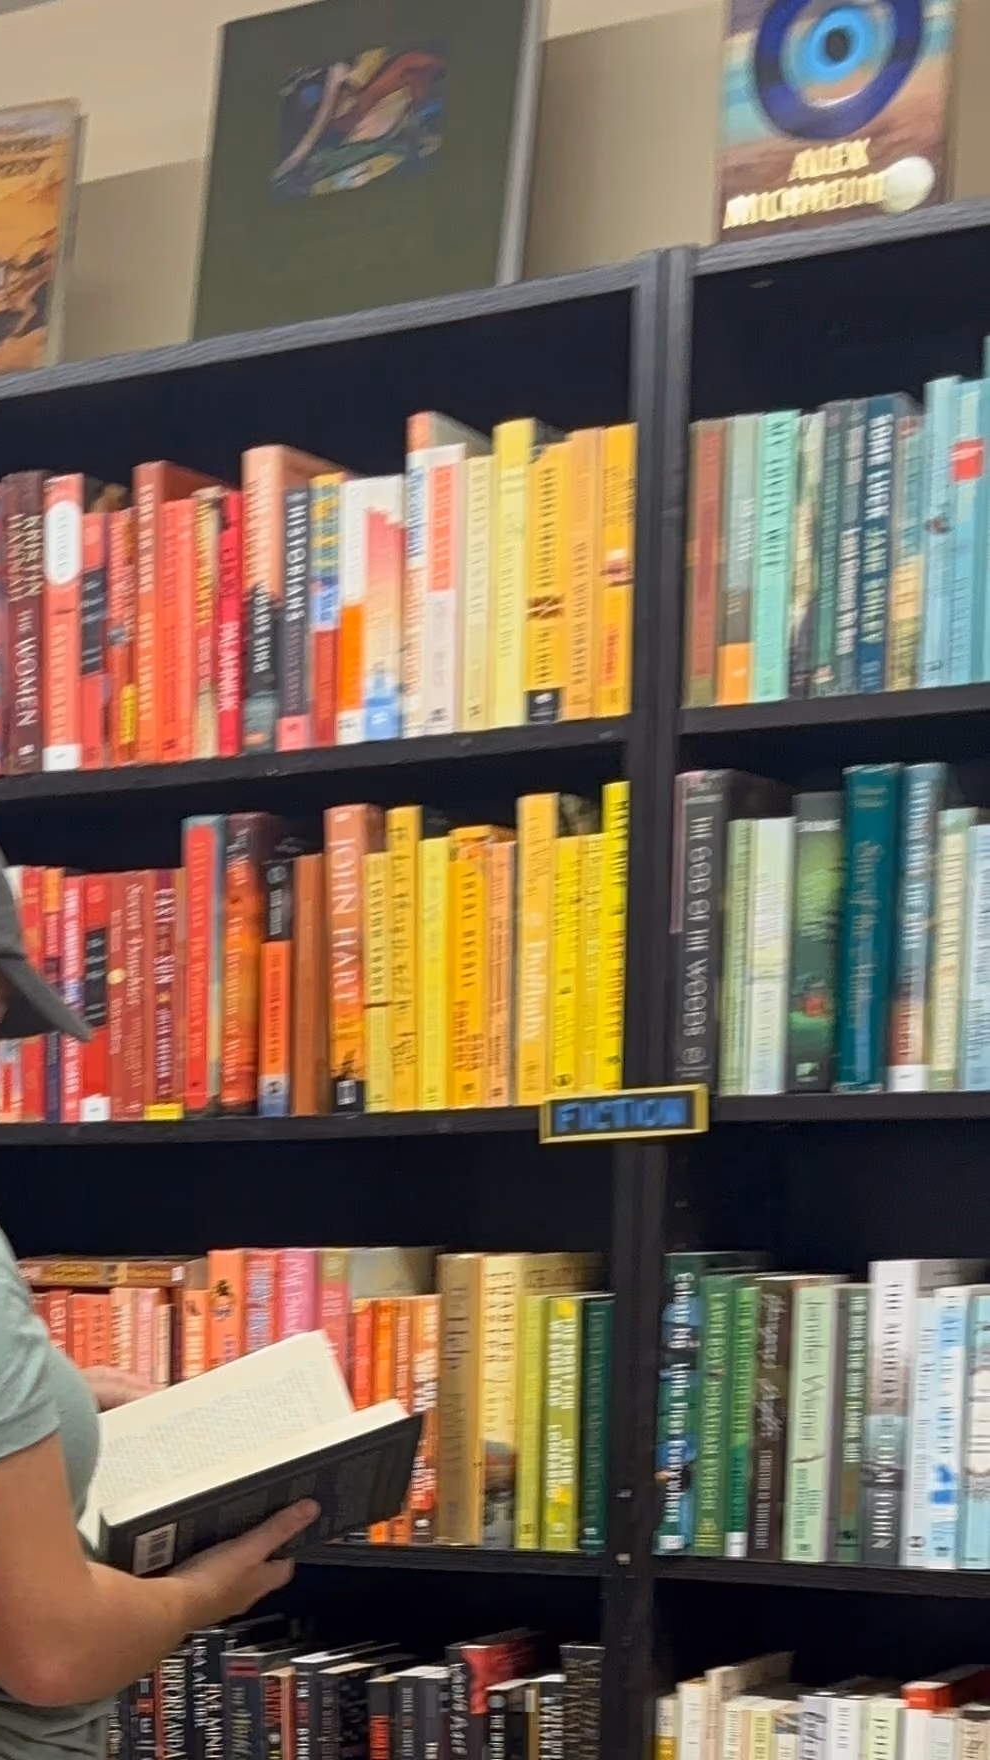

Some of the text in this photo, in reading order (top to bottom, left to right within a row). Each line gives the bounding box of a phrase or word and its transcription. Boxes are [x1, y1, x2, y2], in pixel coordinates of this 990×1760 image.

[866, 413, 894, 521] SOME LUCK
[285, 505, 307, 623] HISTORIANS
[860, 526, 887, 646] JANE SMILEY
[15, 636, 38, 728] WOMEN
[687, 846, 713, 895] GOD
[329, 838, 360, 1004] JOHN HART
[683, 959, 711, 1037] WOODS
[555, 1097, 688, 1133] FICTION
[674, 1272, 696, 1324] Celeste
[671, 1363, 692, 1399] Little
[800, 1297, 828, 1442] Jennifer Weiner
[668, 1402, 690, 1438] Fires
[546, 1424, 562, 1500] LOMBARDO
[561, 1438, 576, 1485] CLAIRE
[663, 1440, 688, 1524] Everywhere
[159, 1658, 187, 1721] BEFORE
